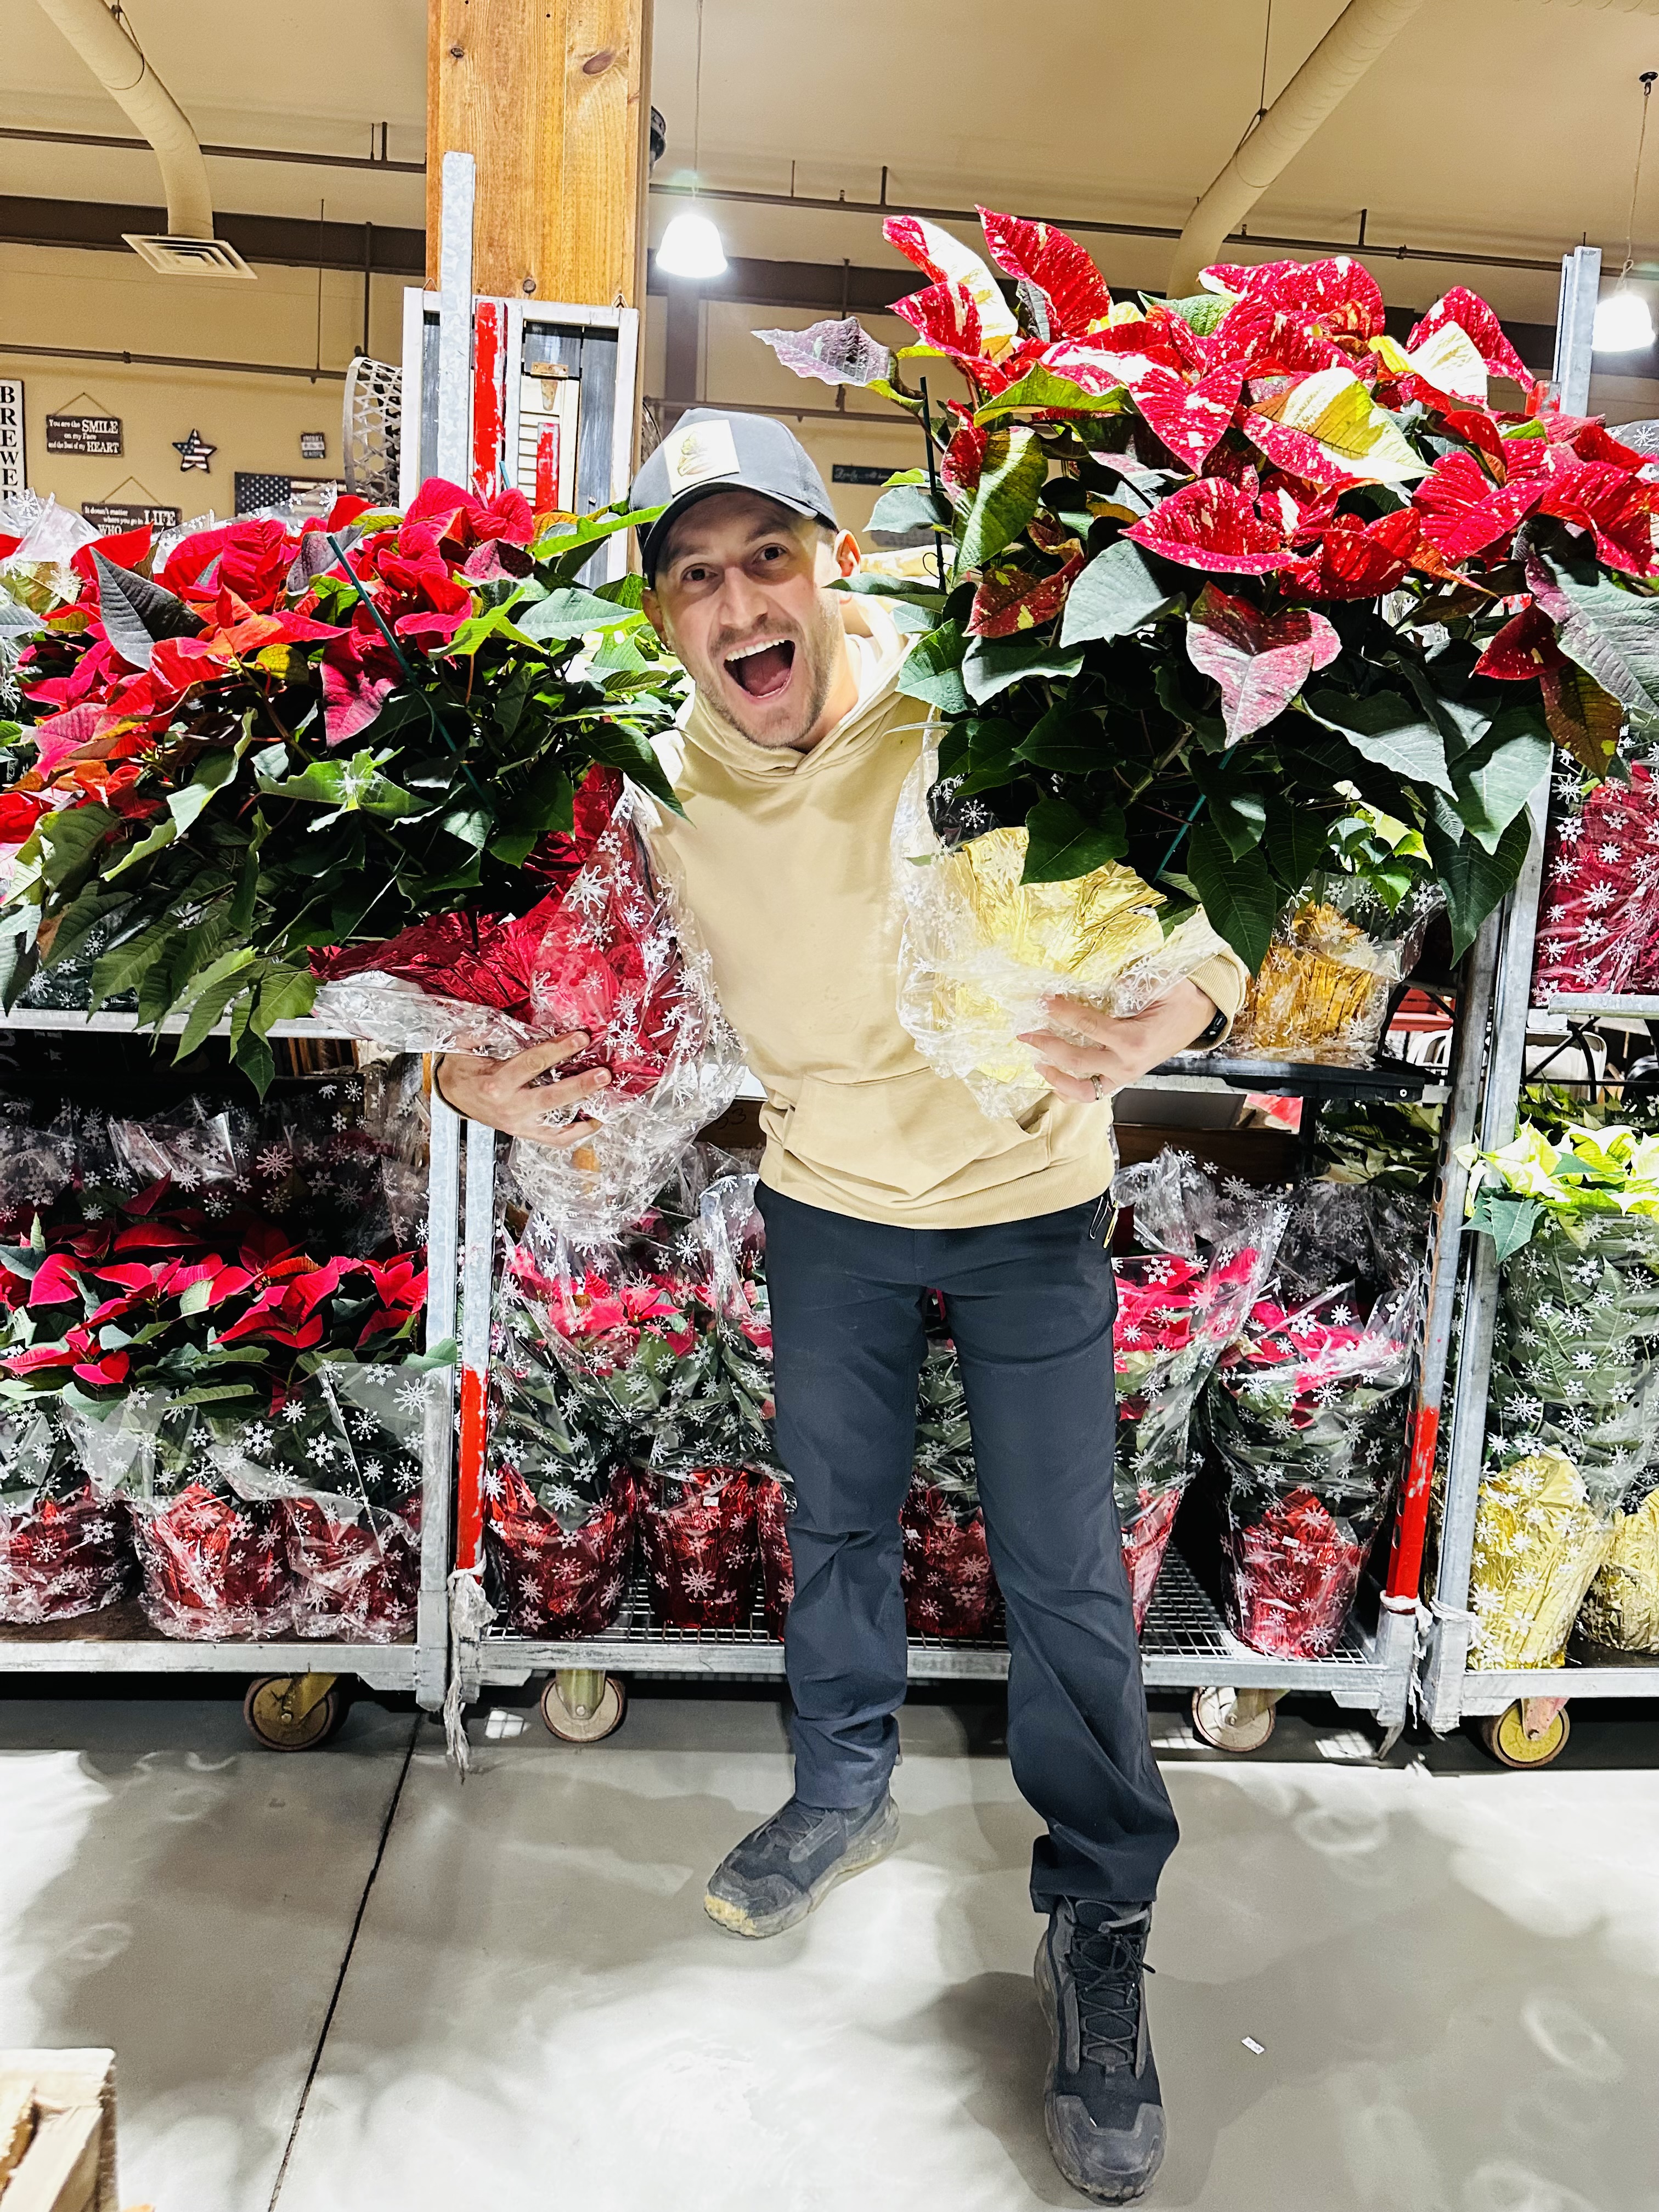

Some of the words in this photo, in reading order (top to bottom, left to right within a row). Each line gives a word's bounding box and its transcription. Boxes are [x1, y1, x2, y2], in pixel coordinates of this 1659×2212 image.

[49, 419, 60, 427] You
[82, 419, 119, 434] SMILE
[87, 441, 119, 453] HEART
[84, 506, 90, 514] It
[91, 507, 109, 515] doesn't
[144, 510, 176, 527] LIFE
[98, 524, 122, 535] WHO
